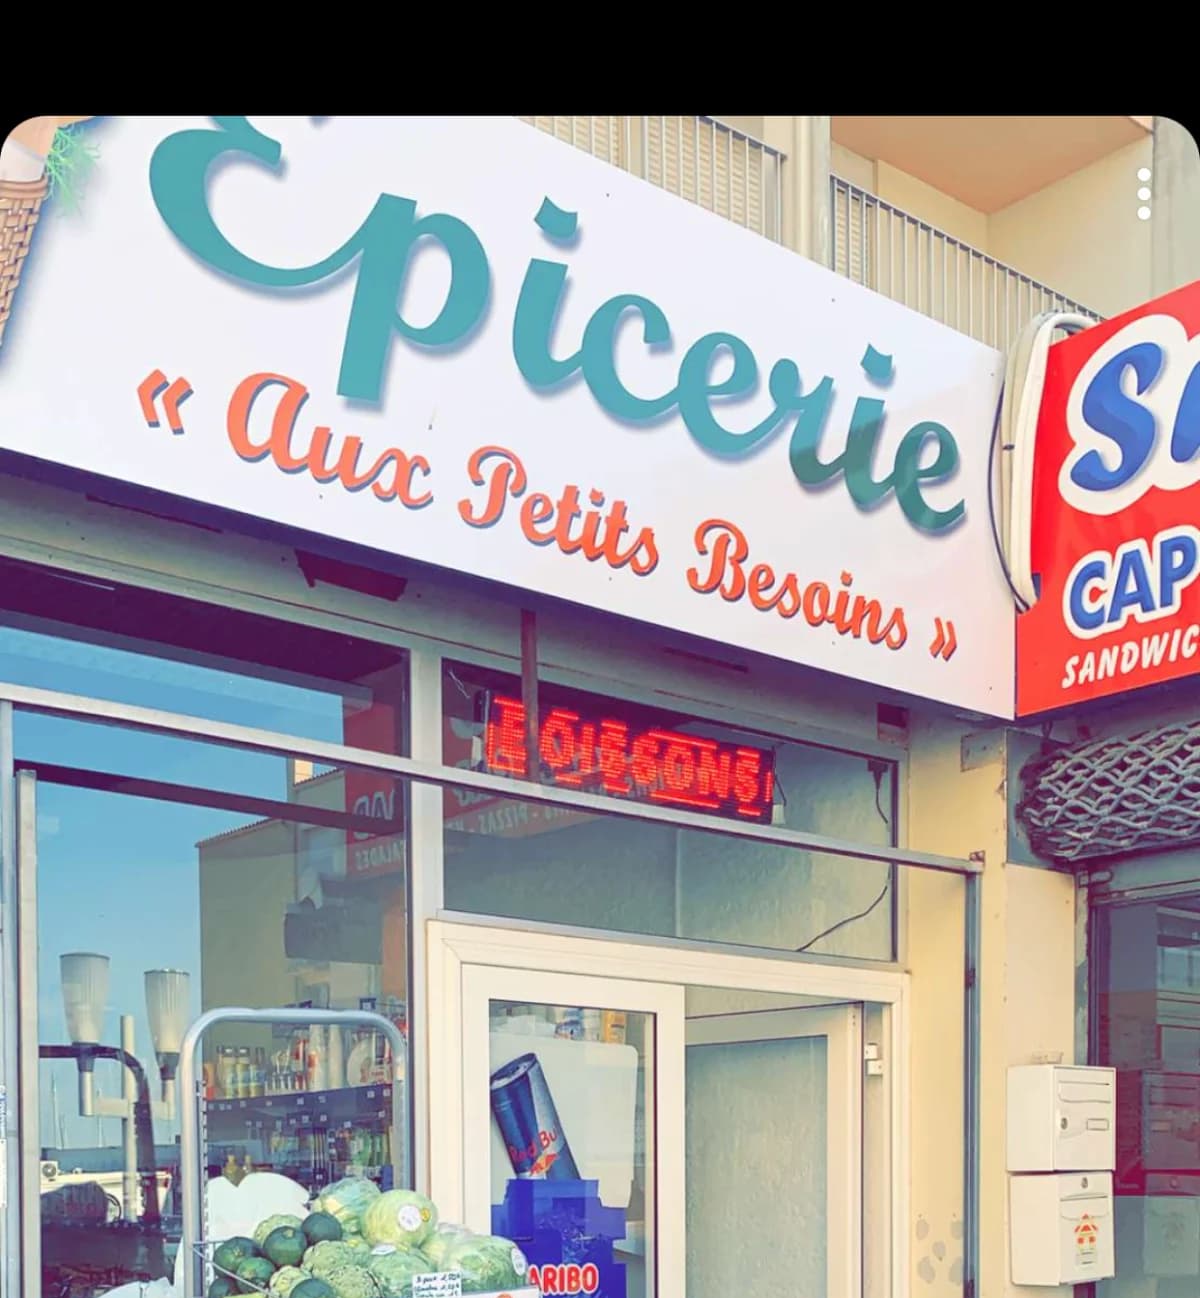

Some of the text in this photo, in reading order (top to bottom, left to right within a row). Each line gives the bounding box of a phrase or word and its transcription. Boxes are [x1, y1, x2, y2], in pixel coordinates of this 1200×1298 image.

[227, 372, 434, 511] Aux
[457, 445, 659, 577] Petits
[686, 518, 908, 650] Besoins
[1068, 534, 1199, 631] CAP
[1061, 624, 1200, 689] SANDWIC
[538, 1128, 557, 1150] Bu
[528, 1263, 599, 1295] ARIBO
